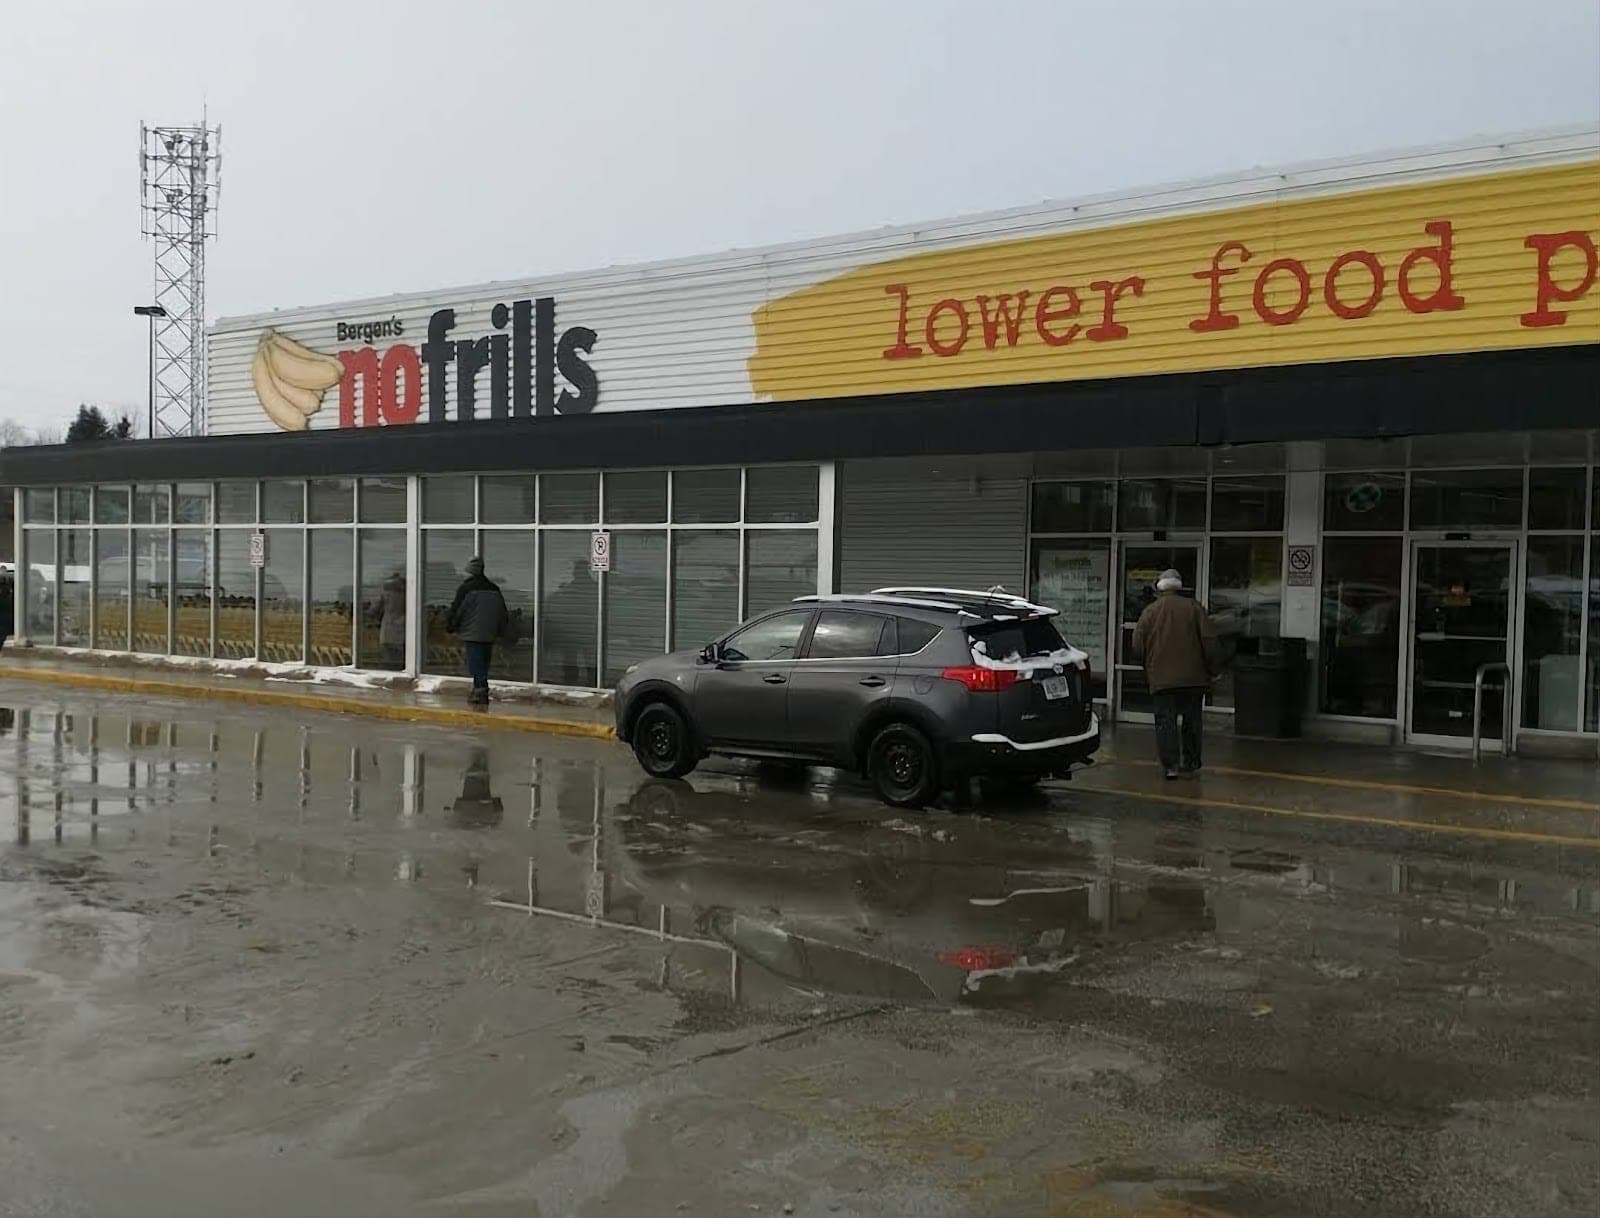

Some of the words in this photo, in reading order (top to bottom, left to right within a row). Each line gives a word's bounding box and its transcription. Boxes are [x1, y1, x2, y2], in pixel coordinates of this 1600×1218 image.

[336, 315, 404, 344] Bergen's
[884, 276, 1143, 360] lower
[1190, 220, 1465, 332] food
